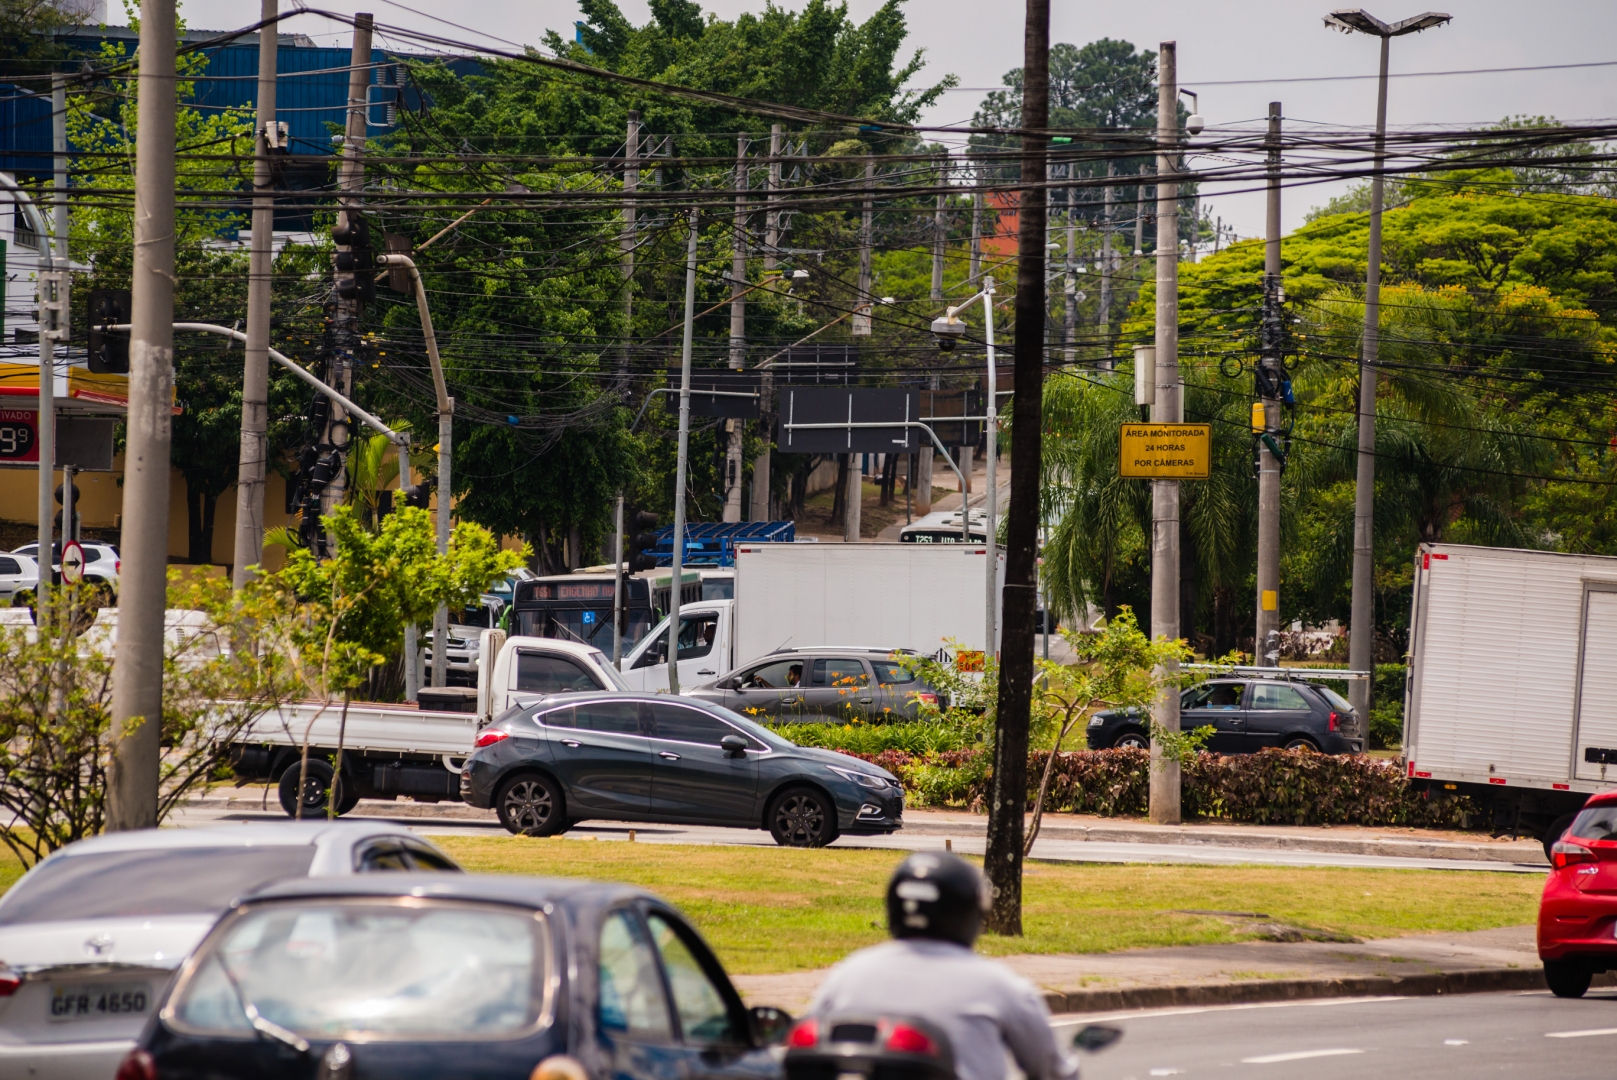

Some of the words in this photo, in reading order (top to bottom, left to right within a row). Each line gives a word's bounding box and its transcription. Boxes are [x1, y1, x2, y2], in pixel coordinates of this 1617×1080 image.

[0, 411, 31, 420] IVADO
[1126, 429, 1148, 437] ÁREA
[1154, 458, 1194, 466] CÂMERAS
[560, 585, 598, 598] ENGENHO
[51, 994, 90, 1016] GFR
[97, 991, 147, 1013] 4650
